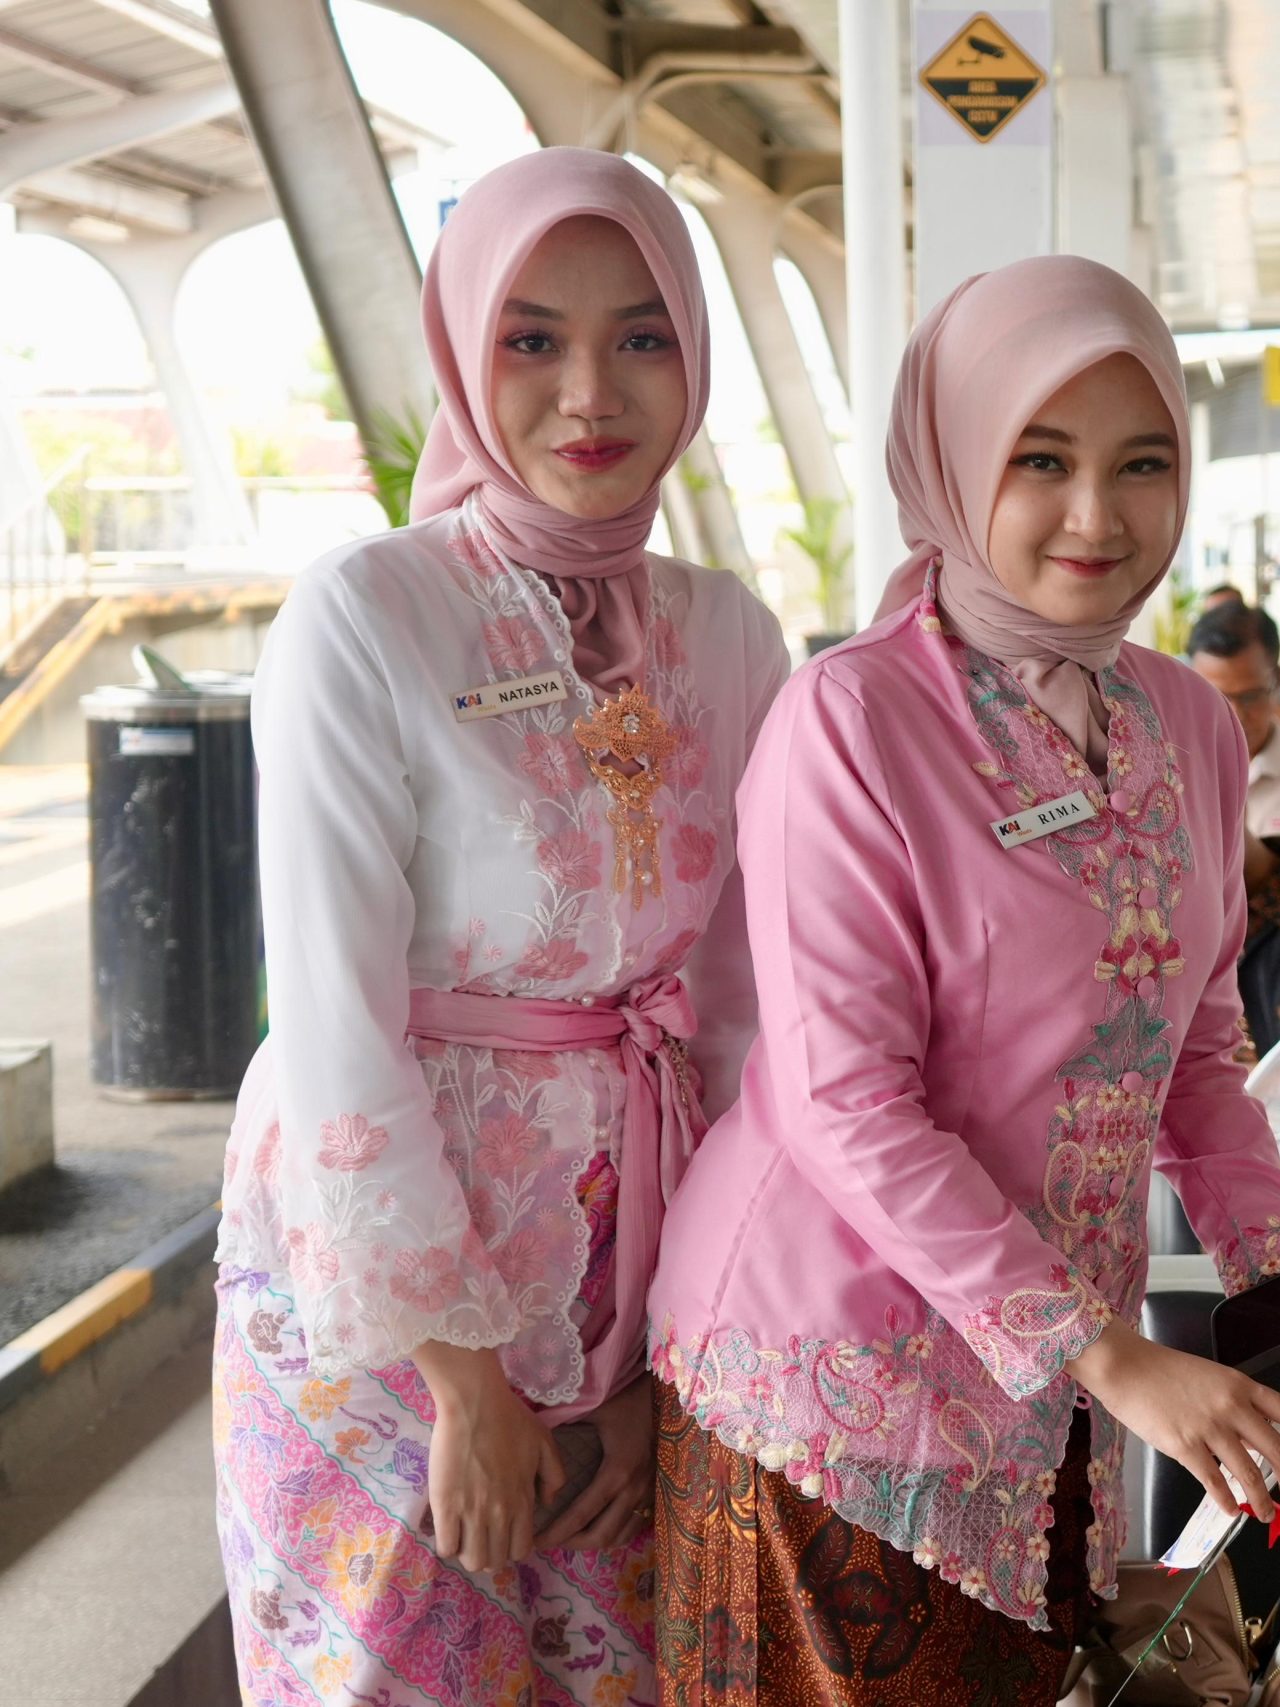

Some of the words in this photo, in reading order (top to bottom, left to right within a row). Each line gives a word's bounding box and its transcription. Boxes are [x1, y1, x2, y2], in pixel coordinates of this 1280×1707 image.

[498, 681, 560, 703] NATASYA
[1037, 802, 1080, 825] RIMA
[999, 820, 1021, 836] KAI
